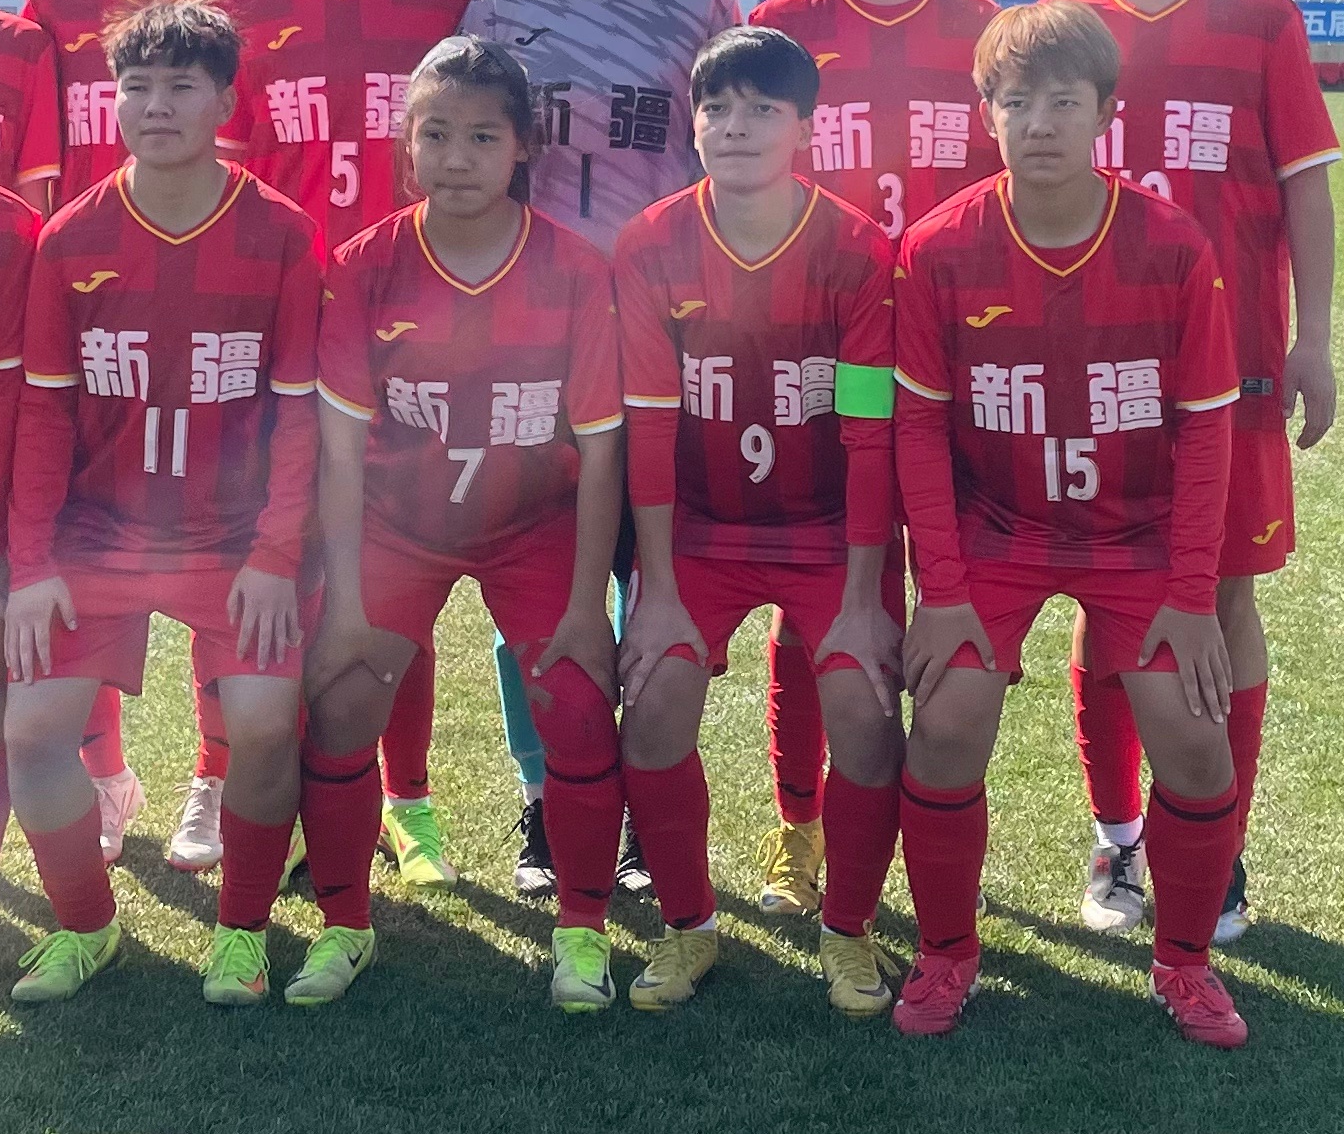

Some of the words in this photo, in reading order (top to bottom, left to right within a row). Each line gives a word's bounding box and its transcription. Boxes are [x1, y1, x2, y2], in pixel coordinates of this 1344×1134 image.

[67, 81, 117, 147] 新
[811, 100, 970, 171] 新疆
[330, 141, 360, 207] 5
[579, 153, 593, 219] 1
[877, 173, 904, 239] 3
[81, 328, 263, 404] 新疆
[682, 351, 837, 426] 新疆
[970, 359, 1163, 435] 新疆
[144, 407, 189, 478] 11
[386, 376, 563, 447] 新疆
[447, 448, 485, 504] 7
[740, 423, 775, 484] 9
[1044, 437, 1101, 503] 15
